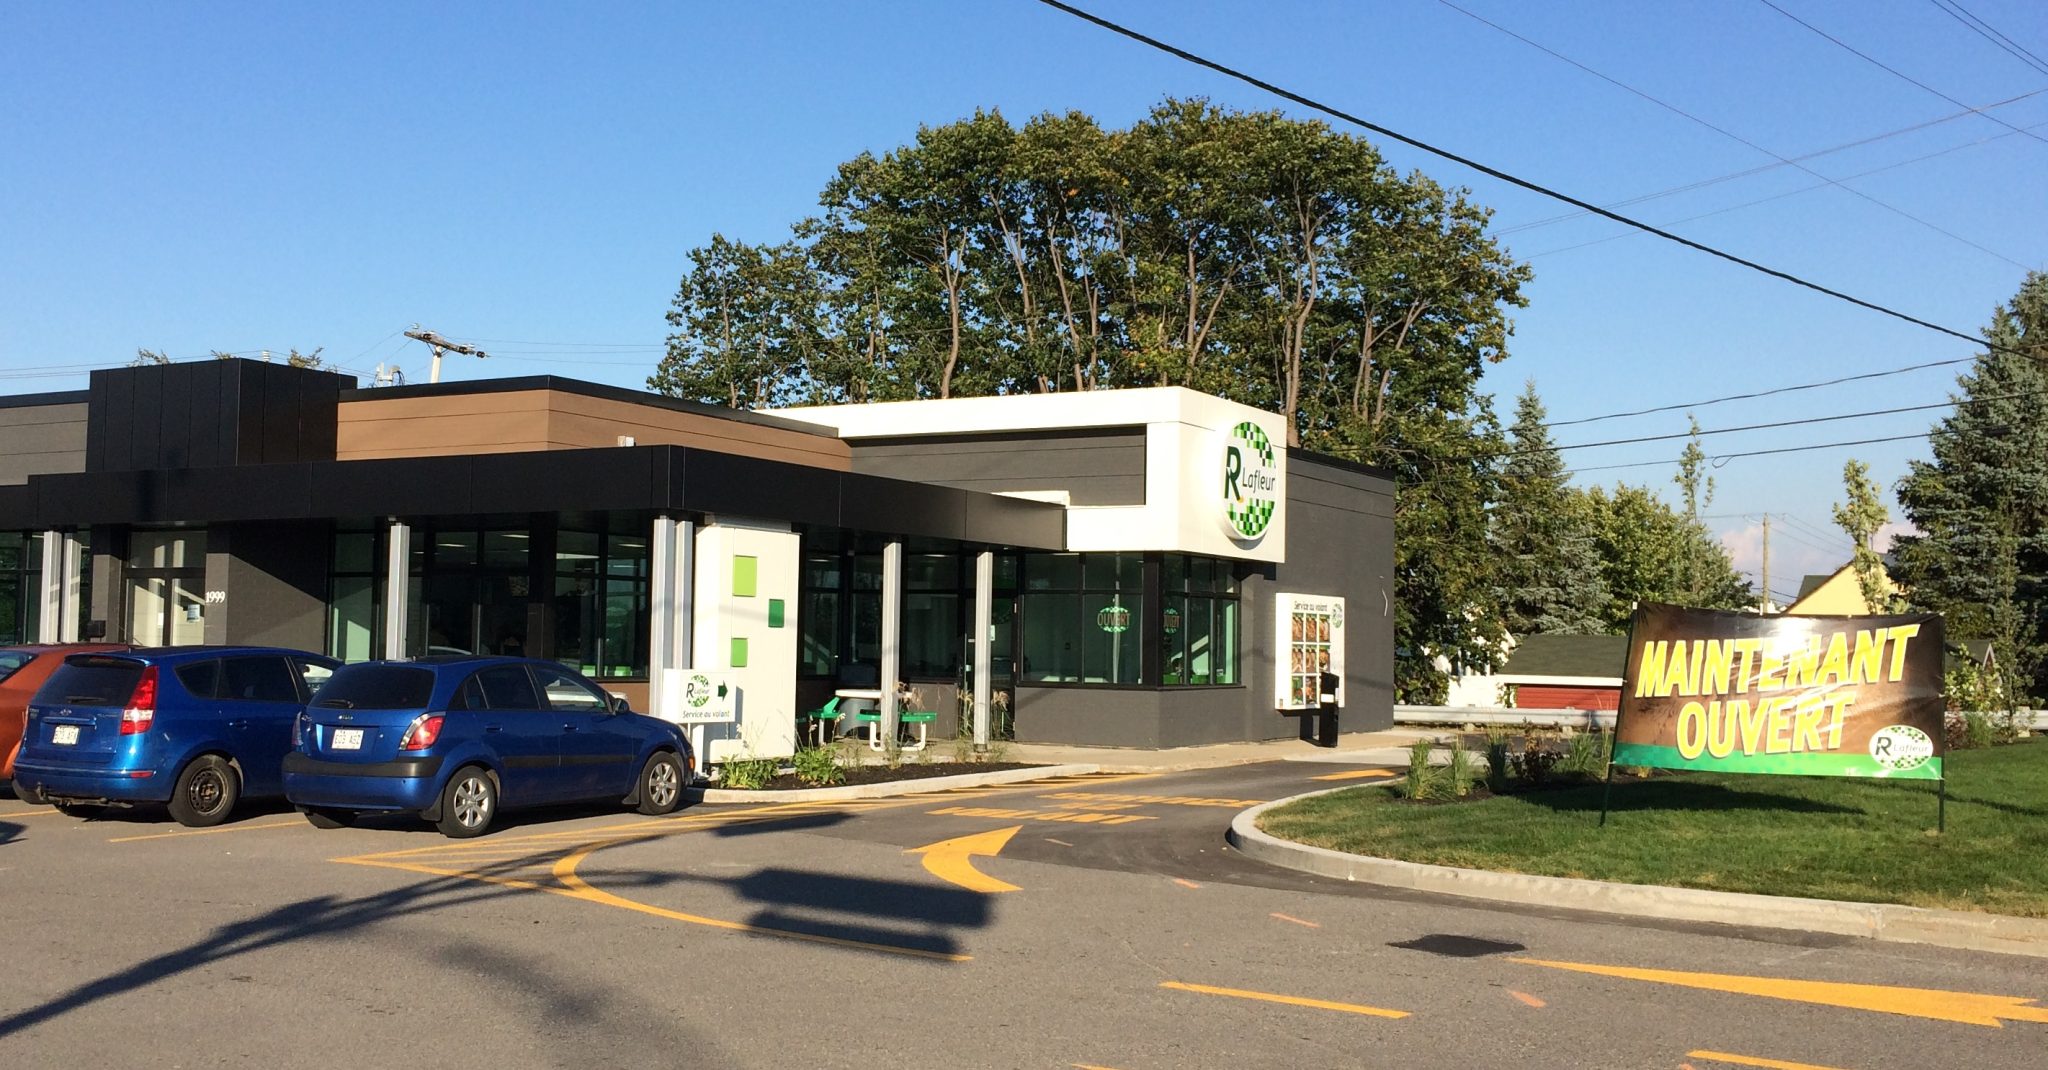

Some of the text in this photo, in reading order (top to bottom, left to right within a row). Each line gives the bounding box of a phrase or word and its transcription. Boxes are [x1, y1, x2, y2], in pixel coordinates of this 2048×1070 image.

[1224, 446, 1276, 501] R Lafleur
[205, 590, 226, 604] 1999
[1097, 613, 1131, 627] OUVERT
[1635, 624, 1920, 698] MAINTENANT
[686, 682, 695, 699] R
[682, 710, 703, 719] Service
[712, 709, 730, 718] volant
[1676, 691, 1857, 760] OUVERT
[1875, 736, 1929, 756] R Lafleur
